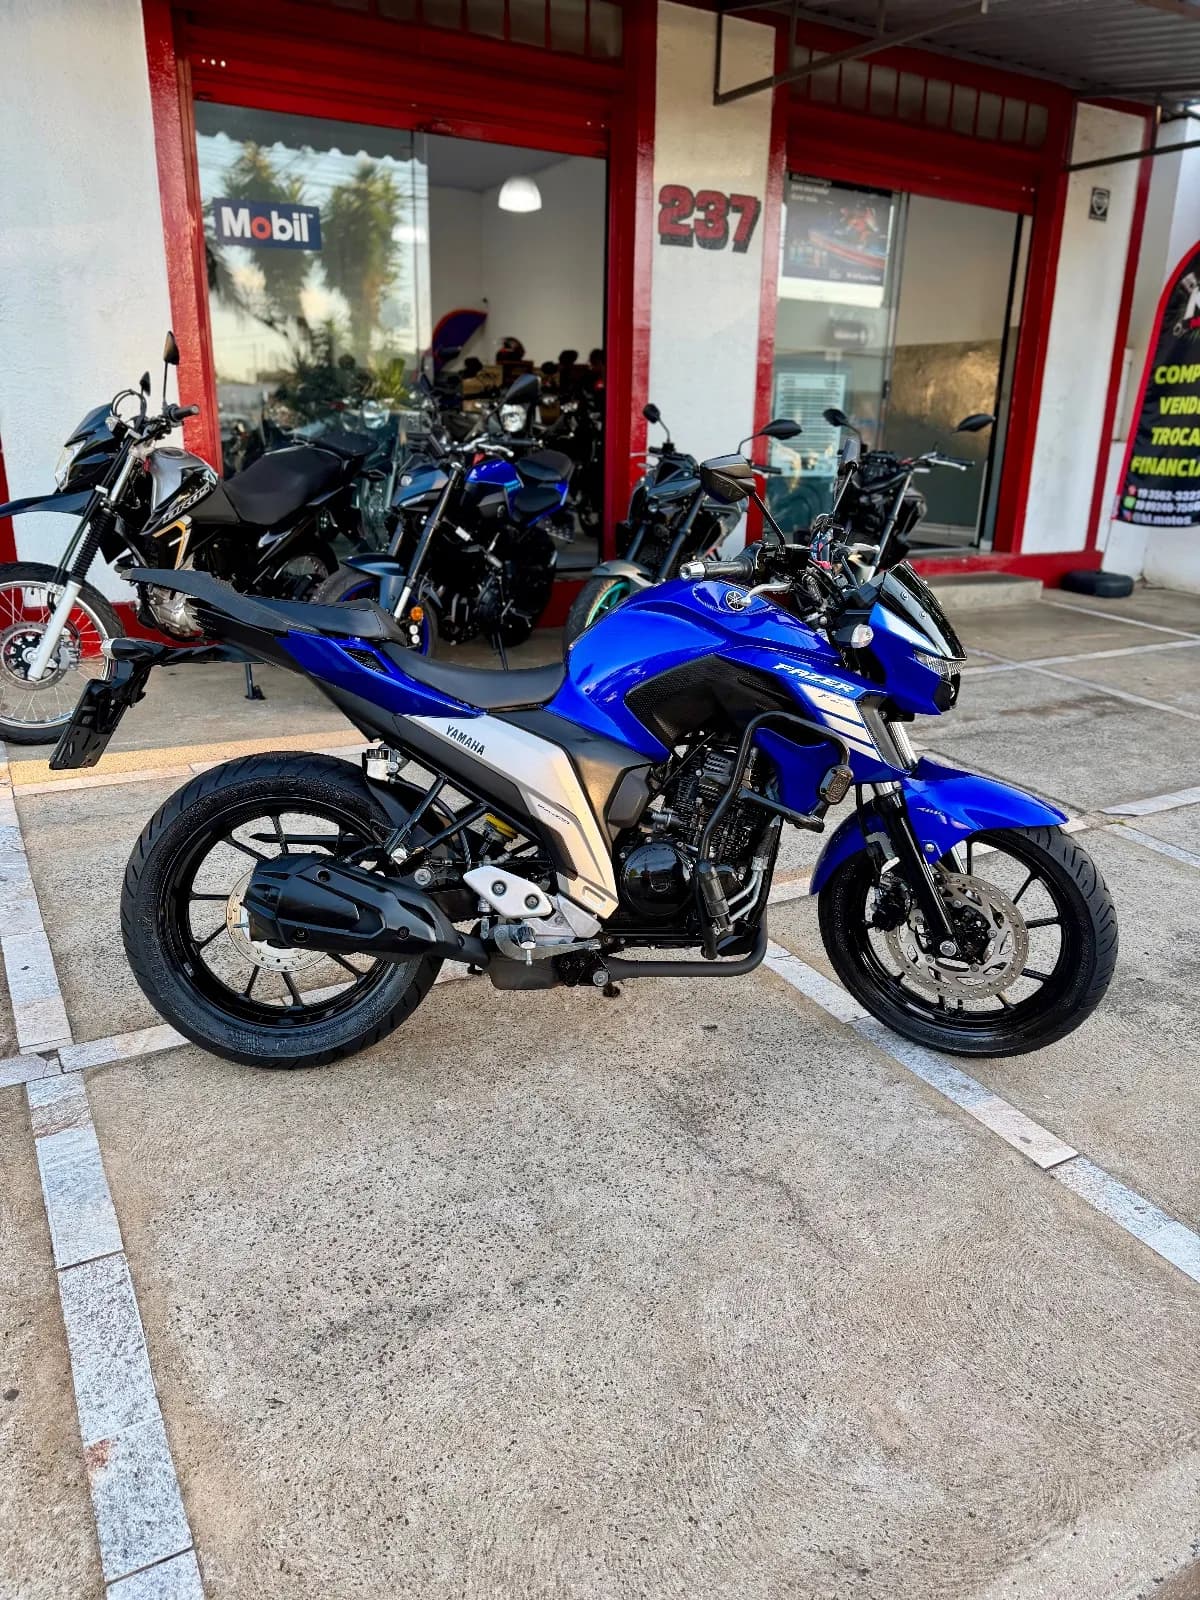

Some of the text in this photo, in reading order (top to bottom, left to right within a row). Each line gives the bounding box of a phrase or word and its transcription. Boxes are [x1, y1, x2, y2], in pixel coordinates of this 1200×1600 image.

[221, 205, 310, 243] Mobil
[658, 184, 762, 253] 237
[1160, 396, 1200, 415] VEND
[1151, 427, 1200, 446] TROCA
[772, 662, 855, 692] FAZER
[446, 724, 485, 756] YAMAHA
